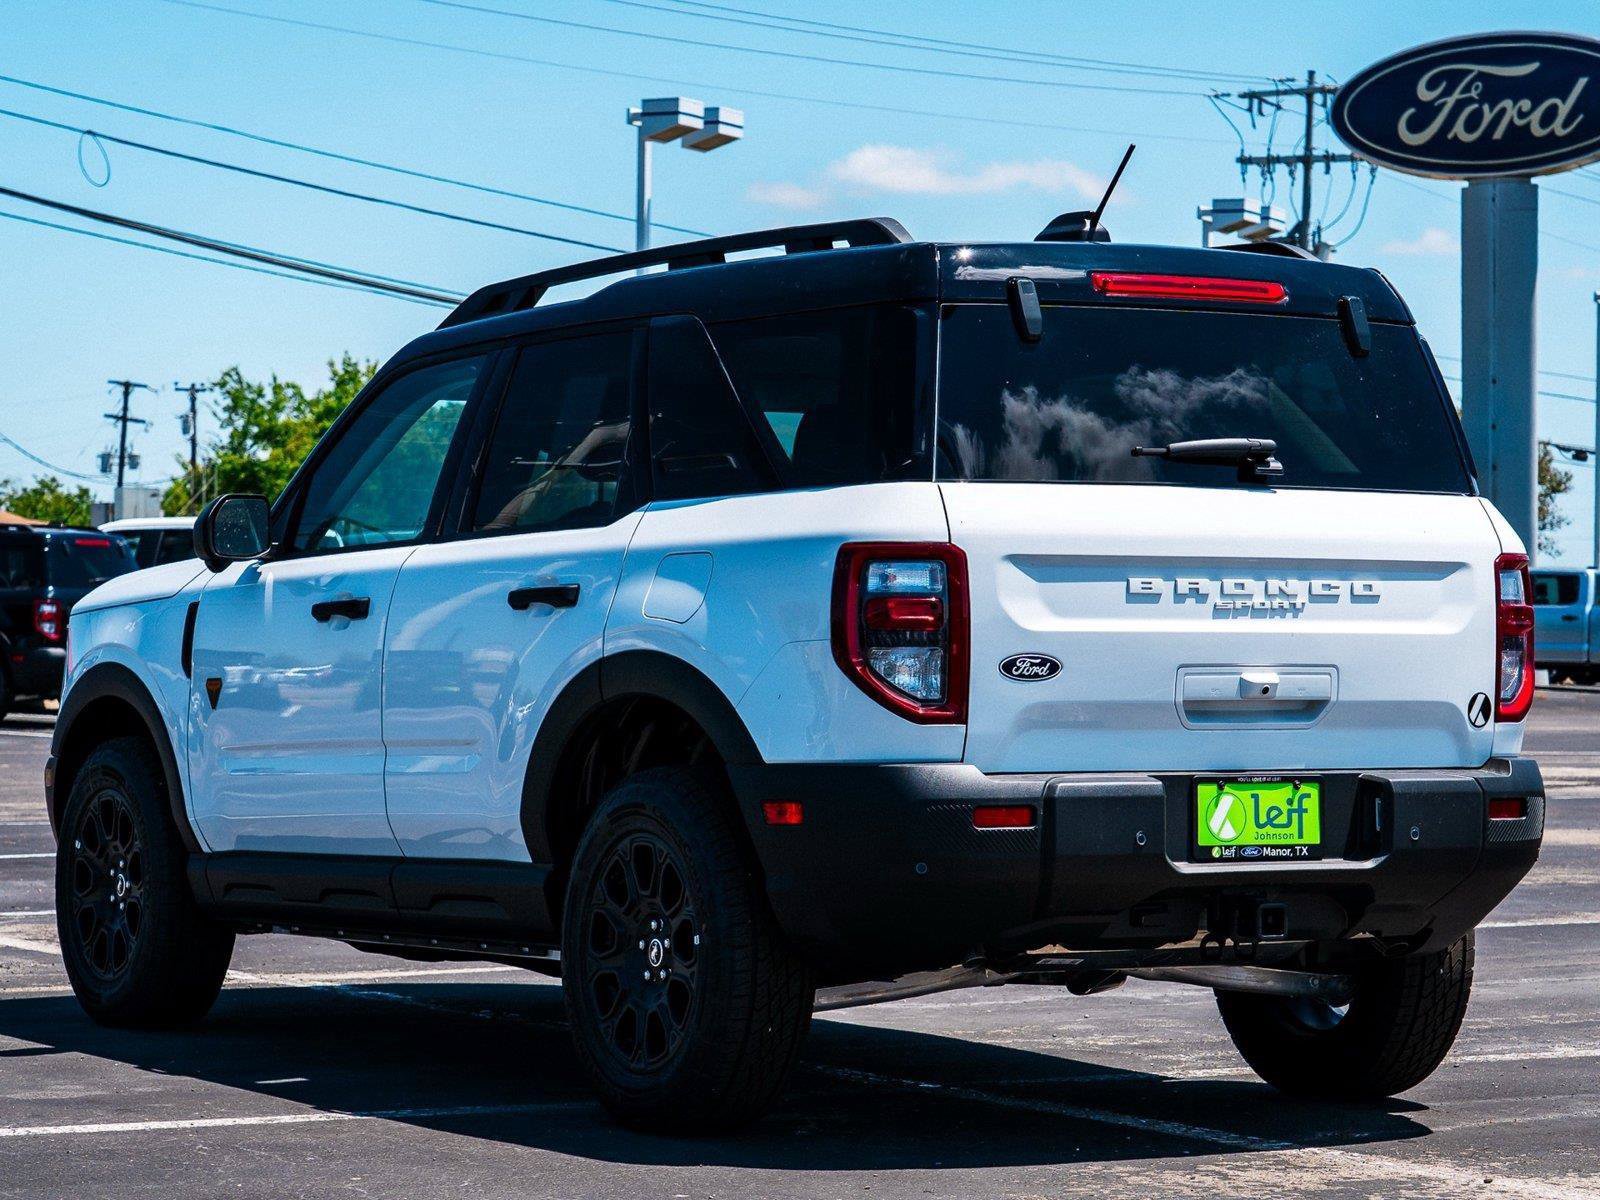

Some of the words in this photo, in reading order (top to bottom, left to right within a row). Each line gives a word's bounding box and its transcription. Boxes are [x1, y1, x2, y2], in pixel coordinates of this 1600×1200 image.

[1397, 61, 1589, 146] Ford
[1127, 577, 1382, 600] BRONCO
[1213, 600, 1306, 614] SPORT
[1012, 657, 1050, 675] Ford
[1254, 831, 1295, 841] Johnson
[1262, 846, 1293, 857] Manor,
[1294, 846, 1309, 856] TX
